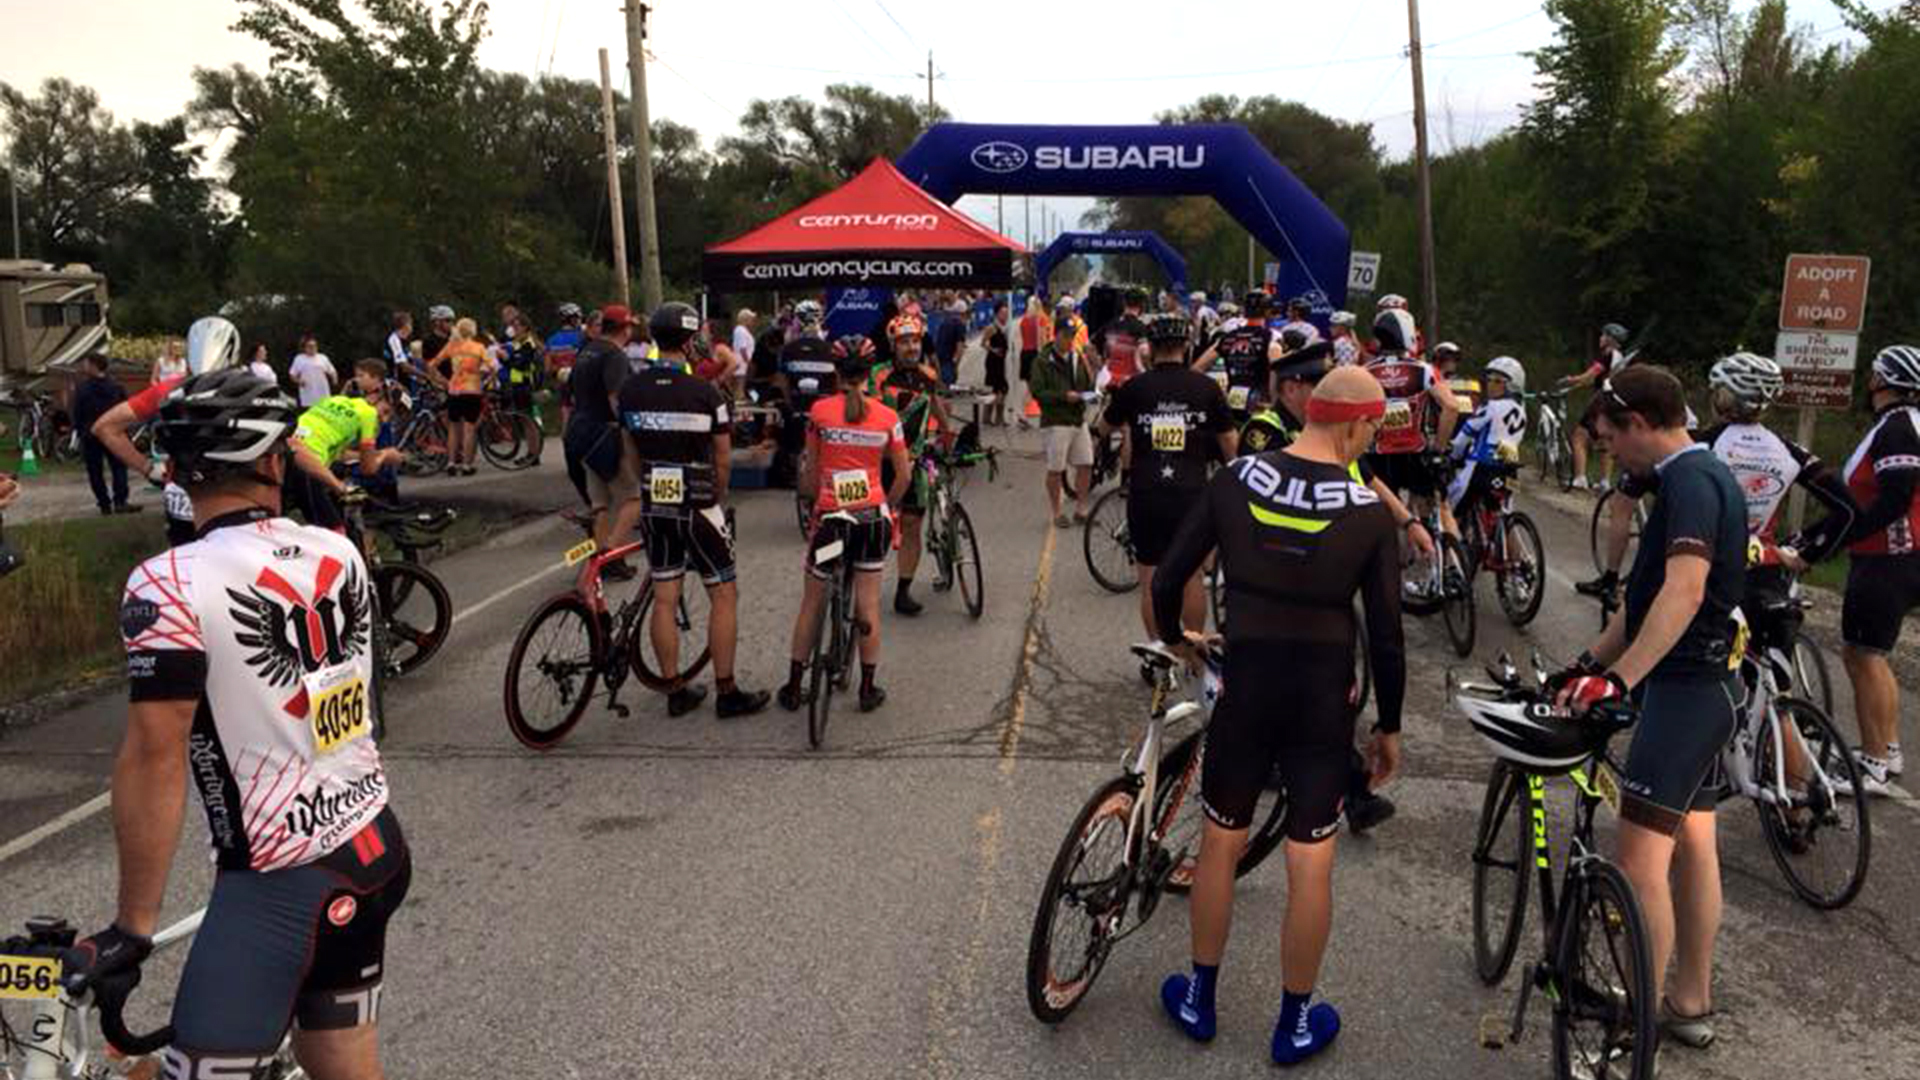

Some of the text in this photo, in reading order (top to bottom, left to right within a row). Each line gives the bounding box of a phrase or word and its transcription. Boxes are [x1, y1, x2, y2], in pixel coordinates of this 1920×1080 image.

[1035, 145, 1204, 170] SUBARU
[1091, 239, 1143, 248] SUBARU
[1353, 267, 1374, 284] 70
[1797, 266, 1857, 282] ADOPT
[1819, 287, 1831, 301] A
[1797, 305, 1847, 320] ROAD
[1807, 335, 1830, 345] THE
[1785, 345, 1849, 358] SHERIDAN
[1793, 356, 1836, 367] FAMILY
[1153, 428, 1183, 447] 4022
[654, 478, 681, 499] 4054
[838, 480, 869, 502] 4028
[315, 681, 363, 745] 4056
[0, 963, 51, 991] 056
